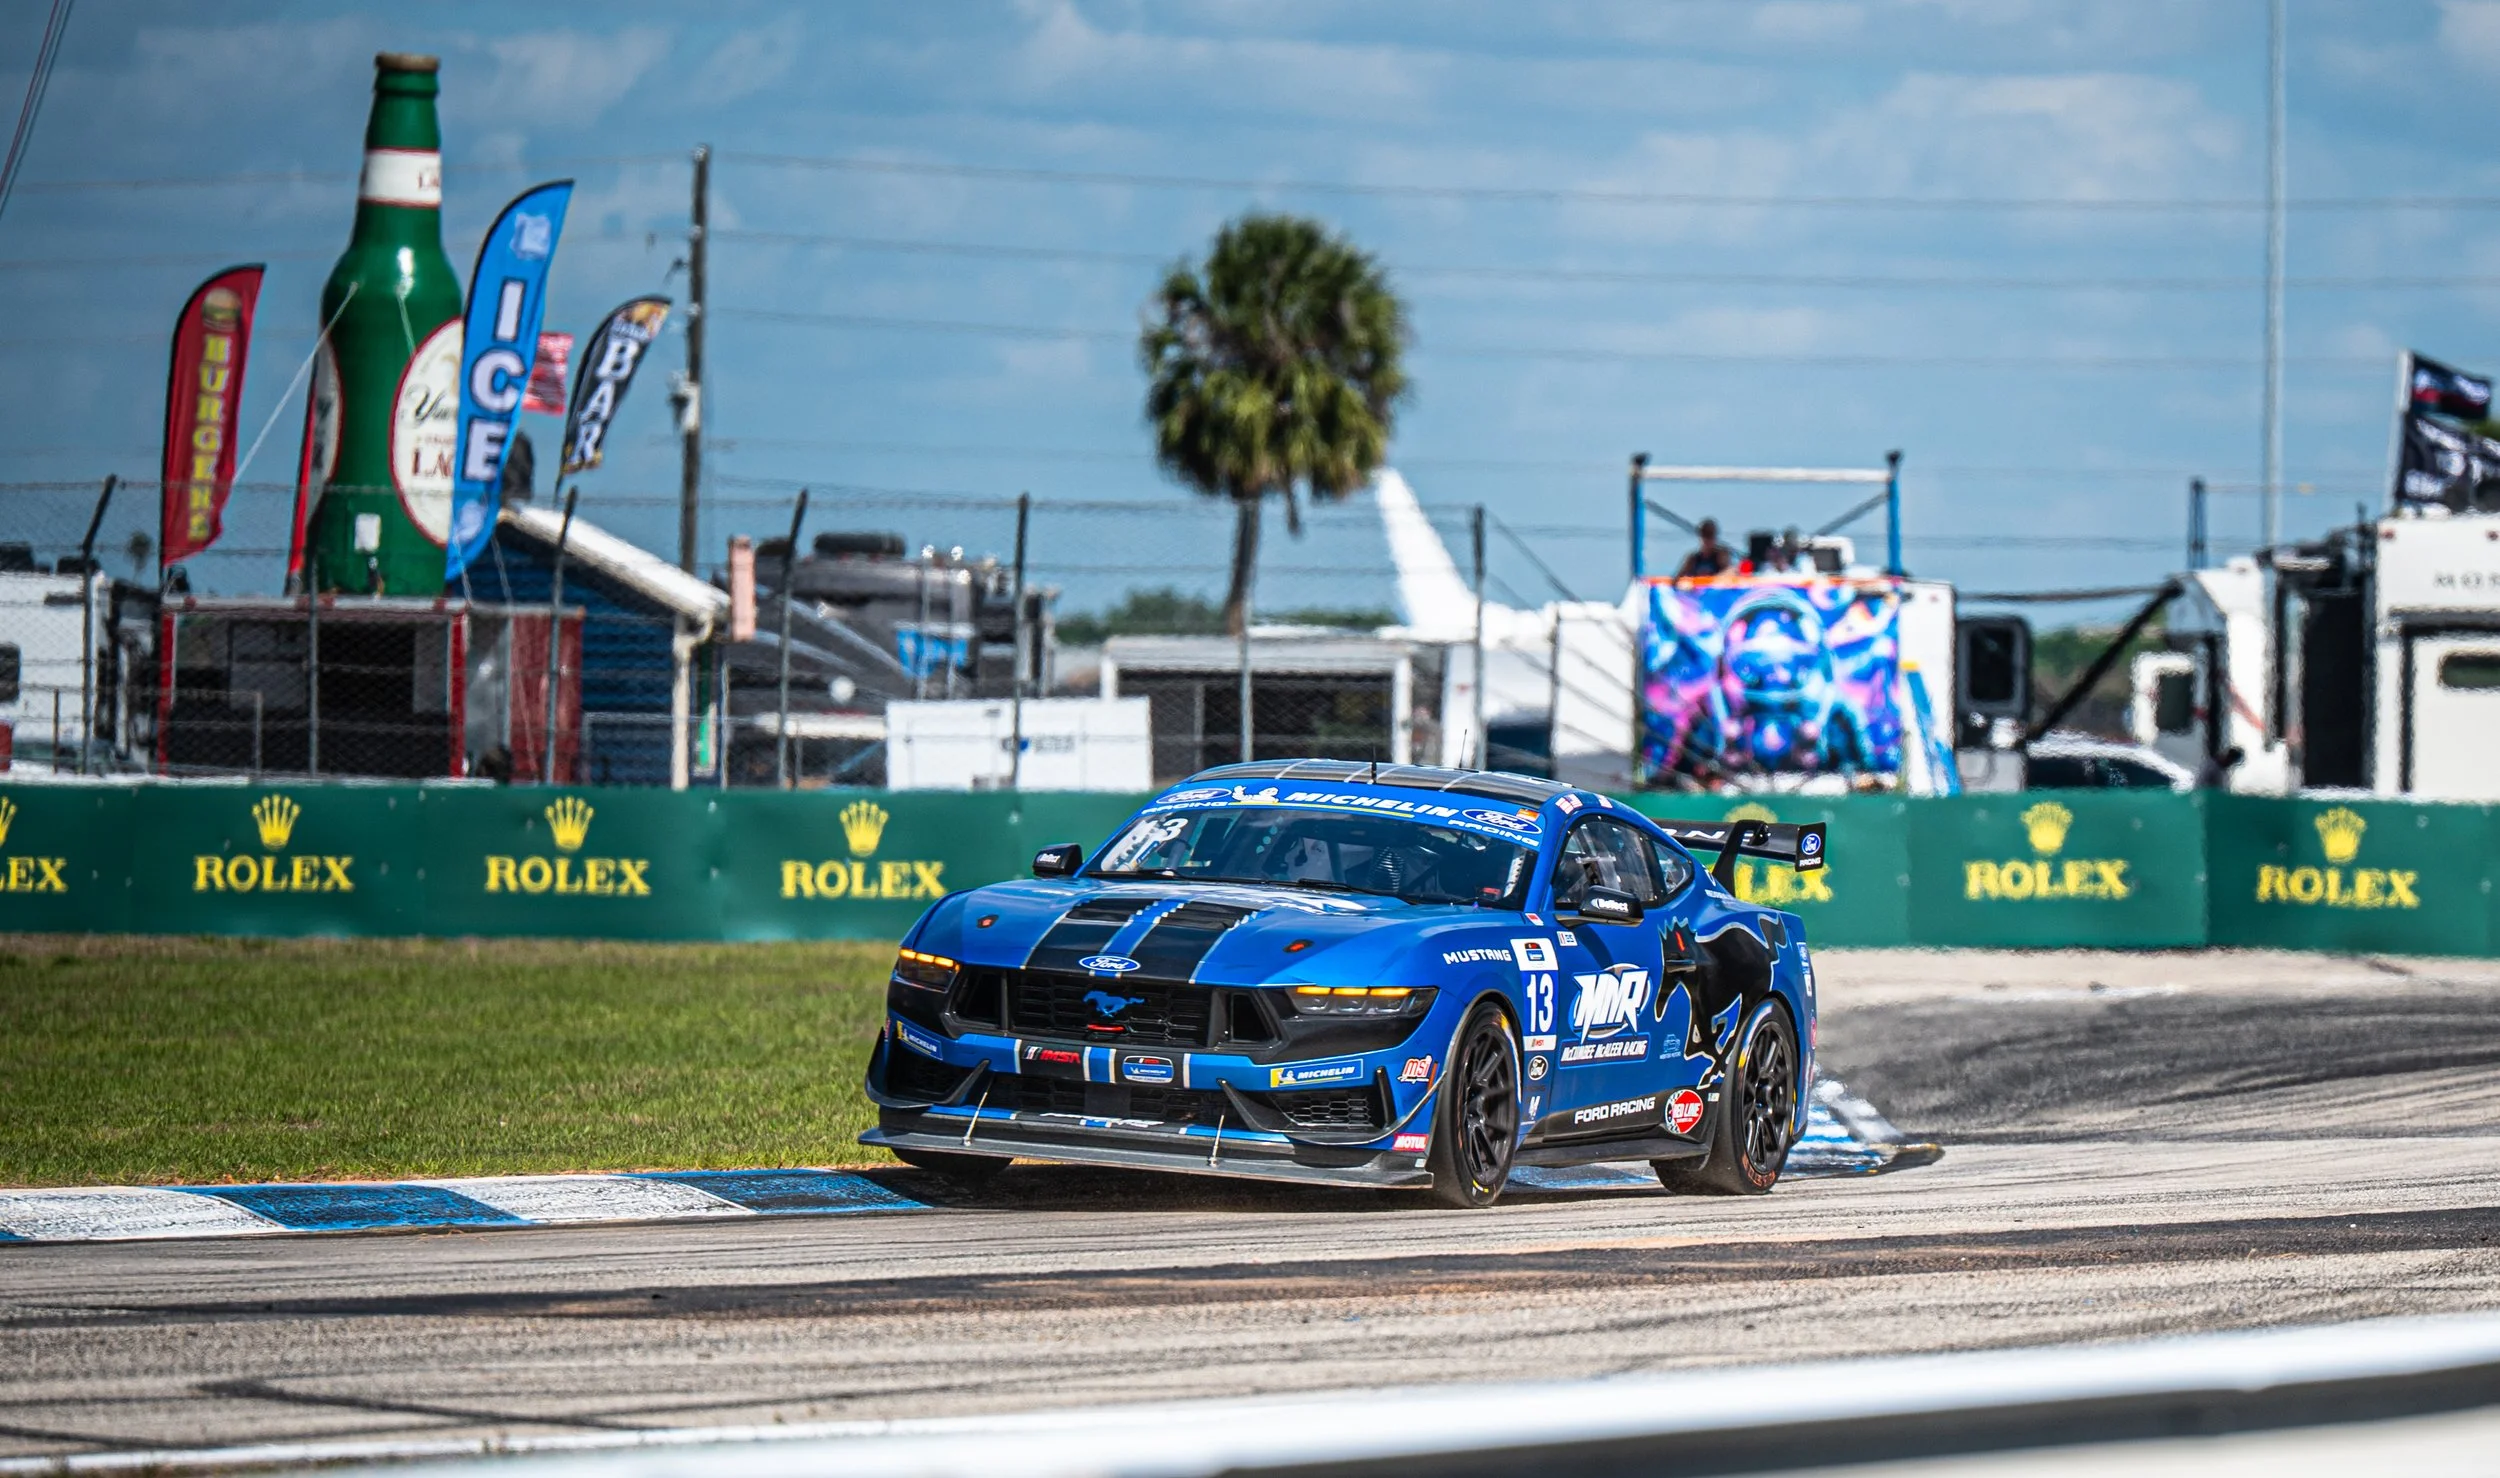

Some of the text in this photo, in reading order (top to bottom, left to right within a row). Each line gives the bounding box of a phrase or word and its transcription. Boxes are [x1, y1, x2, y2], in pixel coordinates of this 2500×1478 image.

[466, 276, 527, 481] ICE
[569, 338, 637, 466] BAR
[1141, 801, 1228, 814] RACING
[1285, 792, 1459, 817] MICHELIN
[1448, 820, 1540, 847] RACING
[0, 857, 67, 891] EX
[195, 856, 354, 891] ROLEX
[485, 857, 651, 895] ROLEX
[1799, 857, 1821, 867] RACING
[781, 859, 948, 901] ROLEX
[1736, 863, 1834, 904] LEX
[1966, 859, 2129, 900] ROLEX
[2256, 867, 2419, 908] ROLEX
[1443, 949, 1512, 964] MUSTANG
[1527, 973, 1554, 1033] 13
[909, 1034, 937, 1052] MICHELIN
[1040, 1049, 1081, 1064] IMSA
[1297, 1066, 1355, 1080] MICHELIN
[1574, 1097, 1656, 1125] FORD RACING
[1395, 1135, 1426, 1150] MOTUL
